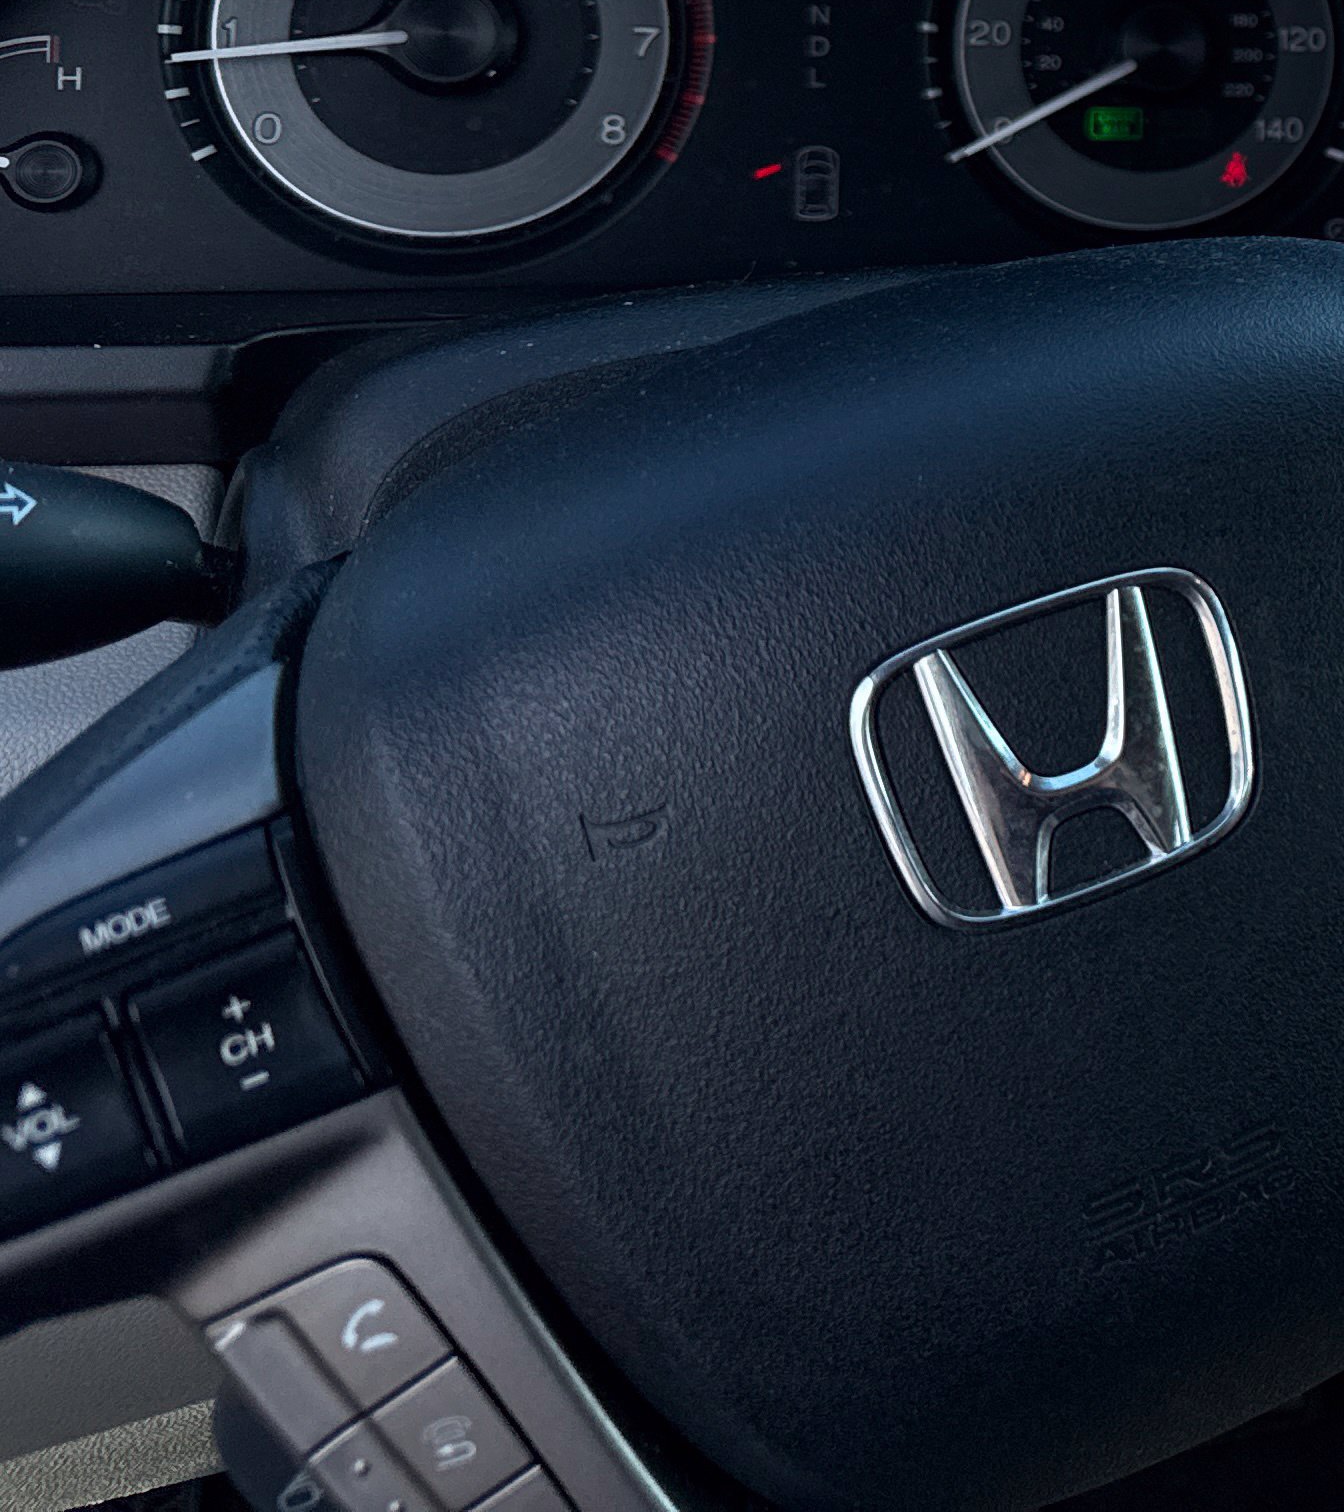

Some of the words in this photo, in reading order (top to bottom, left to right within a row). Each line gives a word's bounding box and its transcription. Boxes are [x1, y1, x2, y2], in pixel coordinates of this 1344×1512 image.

[811, 4, 831, 25] N
[632, 26, 660, 58] 7
[808, 34, 831, 58] D
[968, 19, 1012, 47] 20
[1277, 25, 1328, 53] 120
[57, 67, 82, 90] H
[809, 66, 828, 89] L
[254, 113, 283, 145] 0
[601, 114, 627, 146] 8
[1254, 115, 1305, 143] 140
[79, 897, 172, 955] MODE
[220, 1023, 276, 1067] CH
[2, 1104, 81, 1152] VOL
